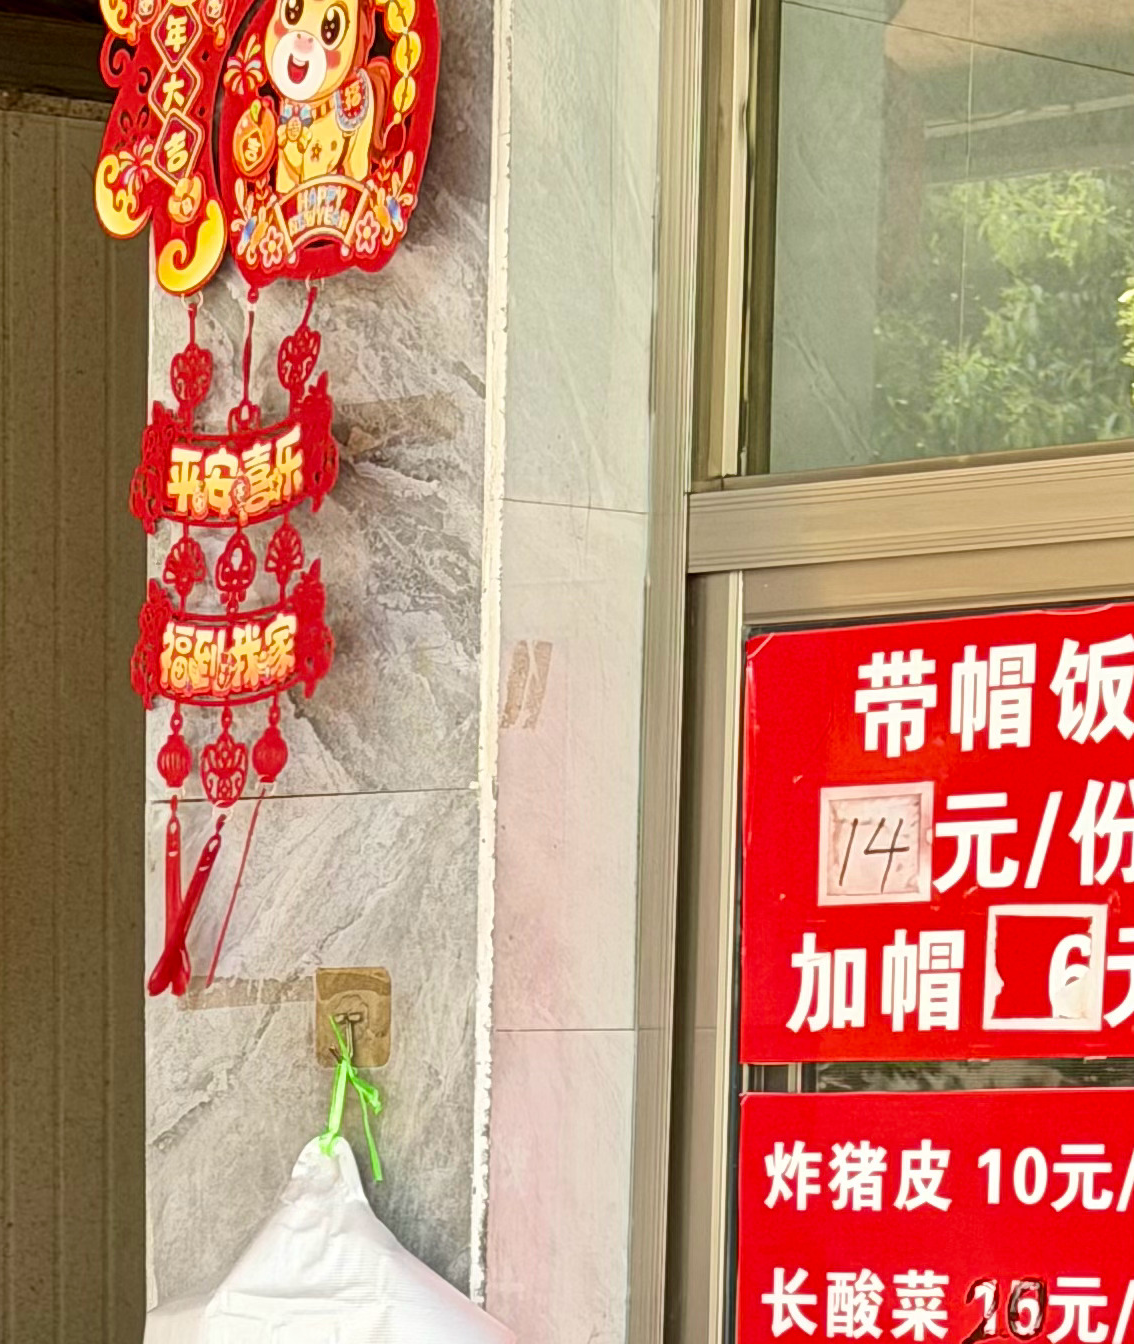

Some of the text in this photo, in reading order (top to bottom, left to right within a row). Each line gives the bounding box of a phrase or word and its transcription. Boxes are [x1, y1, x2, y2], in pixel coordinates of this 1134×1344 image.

[297, 185, 347, 213] HAPPY
[168, 423, 303, 518] 平安喜乐
[854, 632, 1134, 758] 带帽饭
[786, 928, 965, 1033] 加帽
[764, 1138, 952, 1211] 炸猪皮
[761, 1267, 950, 1341] 长酸菜
